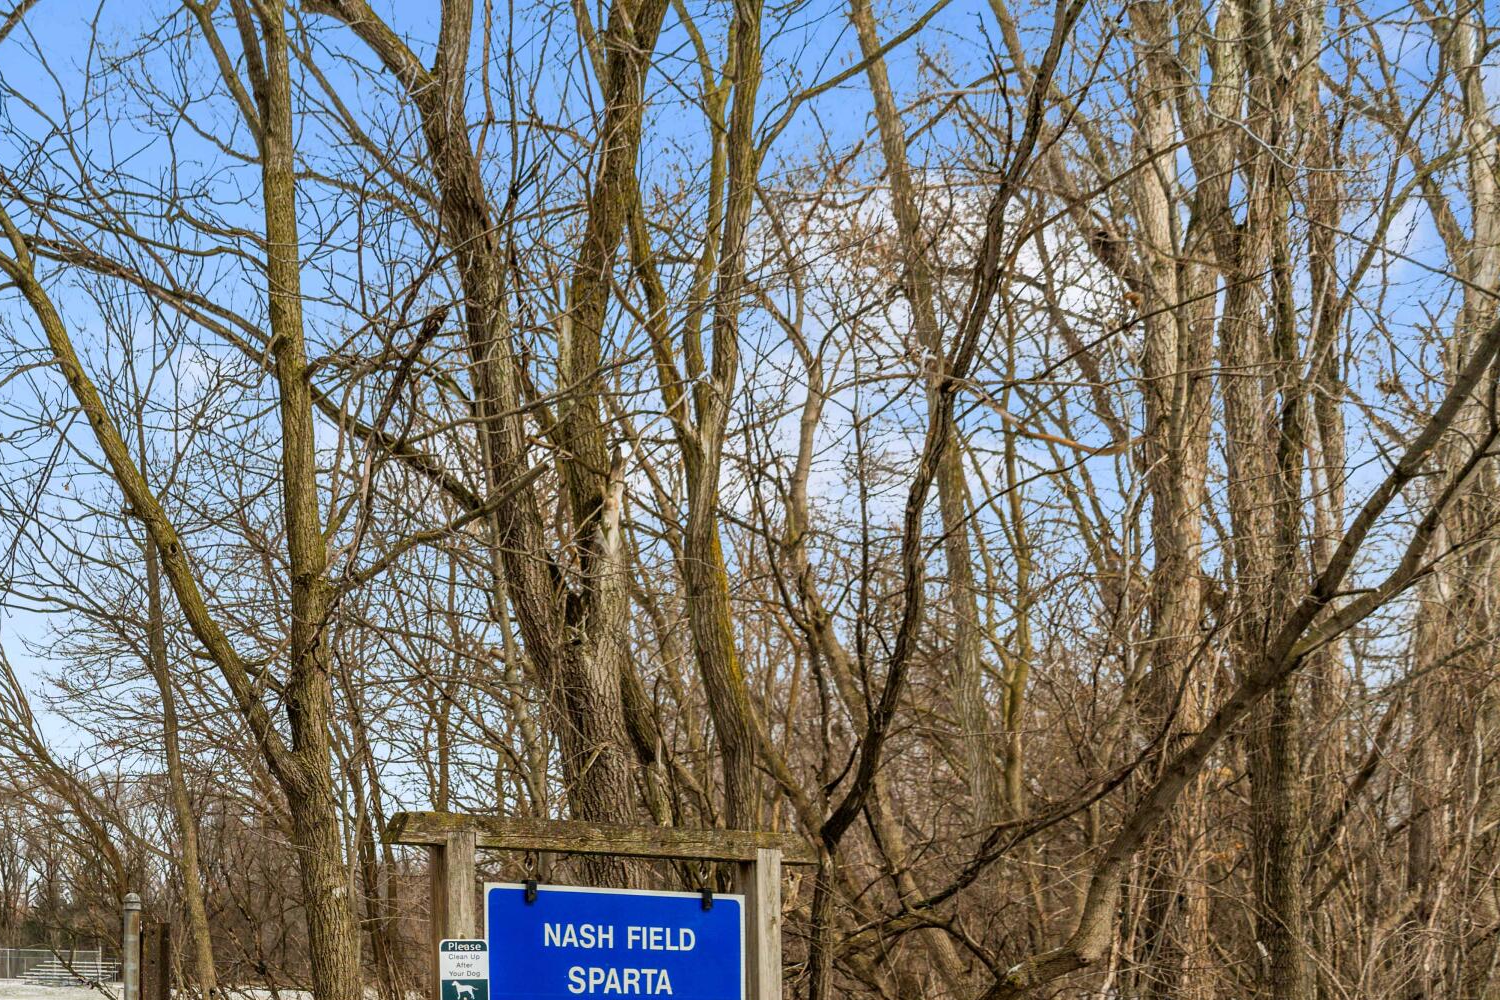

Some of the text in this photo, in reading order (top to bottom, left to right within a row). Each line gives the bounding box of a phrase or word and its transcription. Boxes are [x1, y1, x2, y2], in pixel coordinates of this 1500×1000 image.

[448, 942, 481, 951] Please
[544, 923, 696, 951] NASH FIELD
[567, 966, 673, 995] SPARTA
